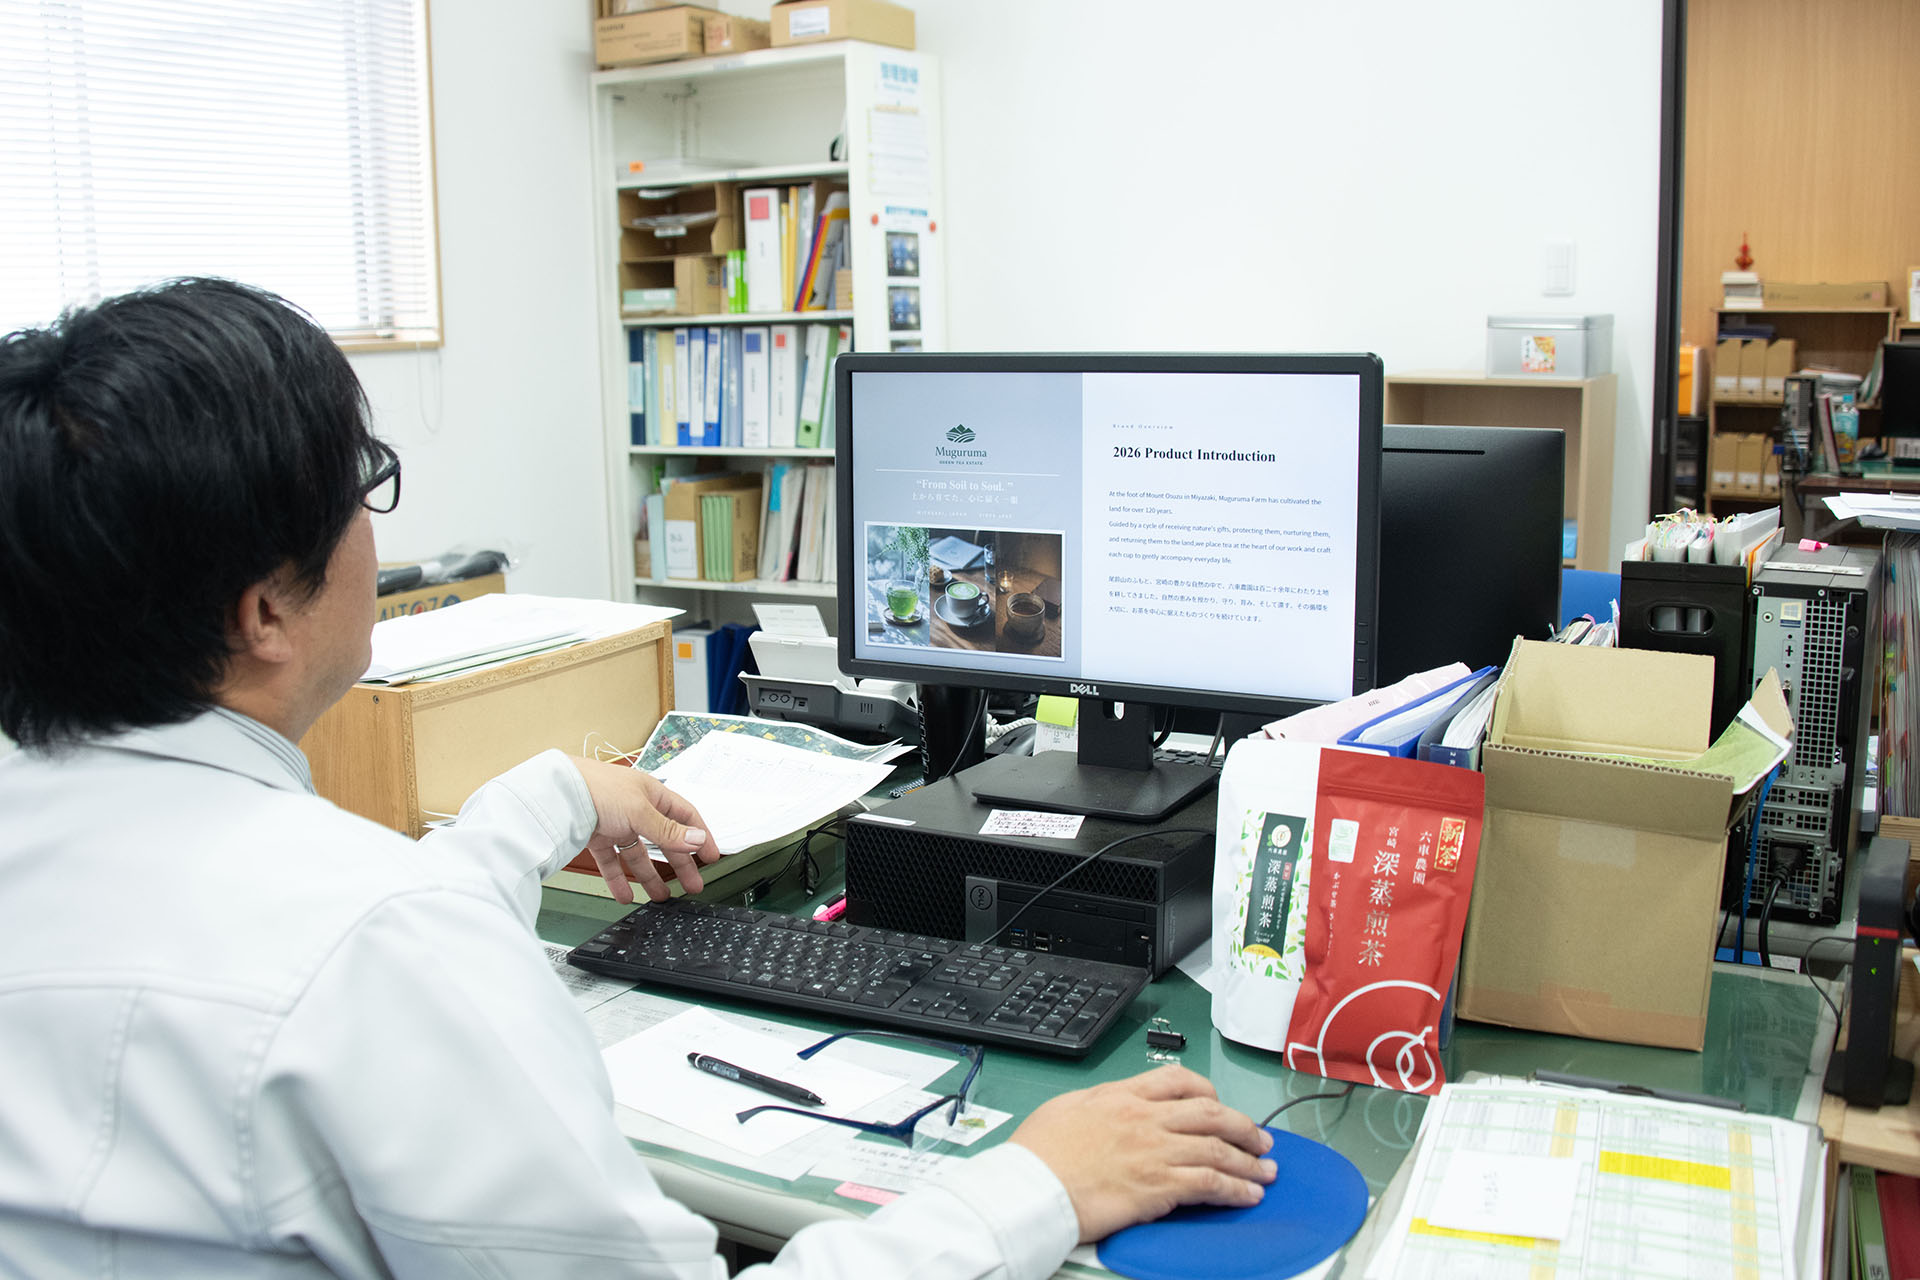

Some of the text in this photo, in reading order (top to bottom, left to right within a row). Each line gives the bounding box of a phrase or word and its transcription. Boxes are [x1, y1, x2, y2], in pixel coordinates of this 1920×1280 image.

[935, 446, 987, 459] Muguruma
[1113, 446, 1276, 462] 2026 Product Introduction
[949, 480, 967, 490] Soil
[970, 481, 979, 490] to
[1219, 495, 1250, 504] Muguruma
[1280, 497, 1309, 505] cultivated
[1130, 522, 1137, 530] by
[1143, 522, 1157, 531] cycle
[1165, 523, 1191, 532] receiving
[1233, 527, 1263, 536] protecting
[1283, 529, 1311, 538] nurturing
[1121, 536, 1147, 545] returning
[1206, 541, 1221, 549] place
[1160, 555, 1193, 563] accompany
[1194, 555, 1220, 564] everyday
[1070, 683, 1099, 696] DELL
[1387, 826, 1399, 849] 宮崎
[1439, 823, 1462, 867] 新茶
[1412, 831, 1432, 885] 六車農園
[1259, 858, 1282, 928] 深蒸煎茶
[1358, 850, 1400, 967] 深蒸煎茶
